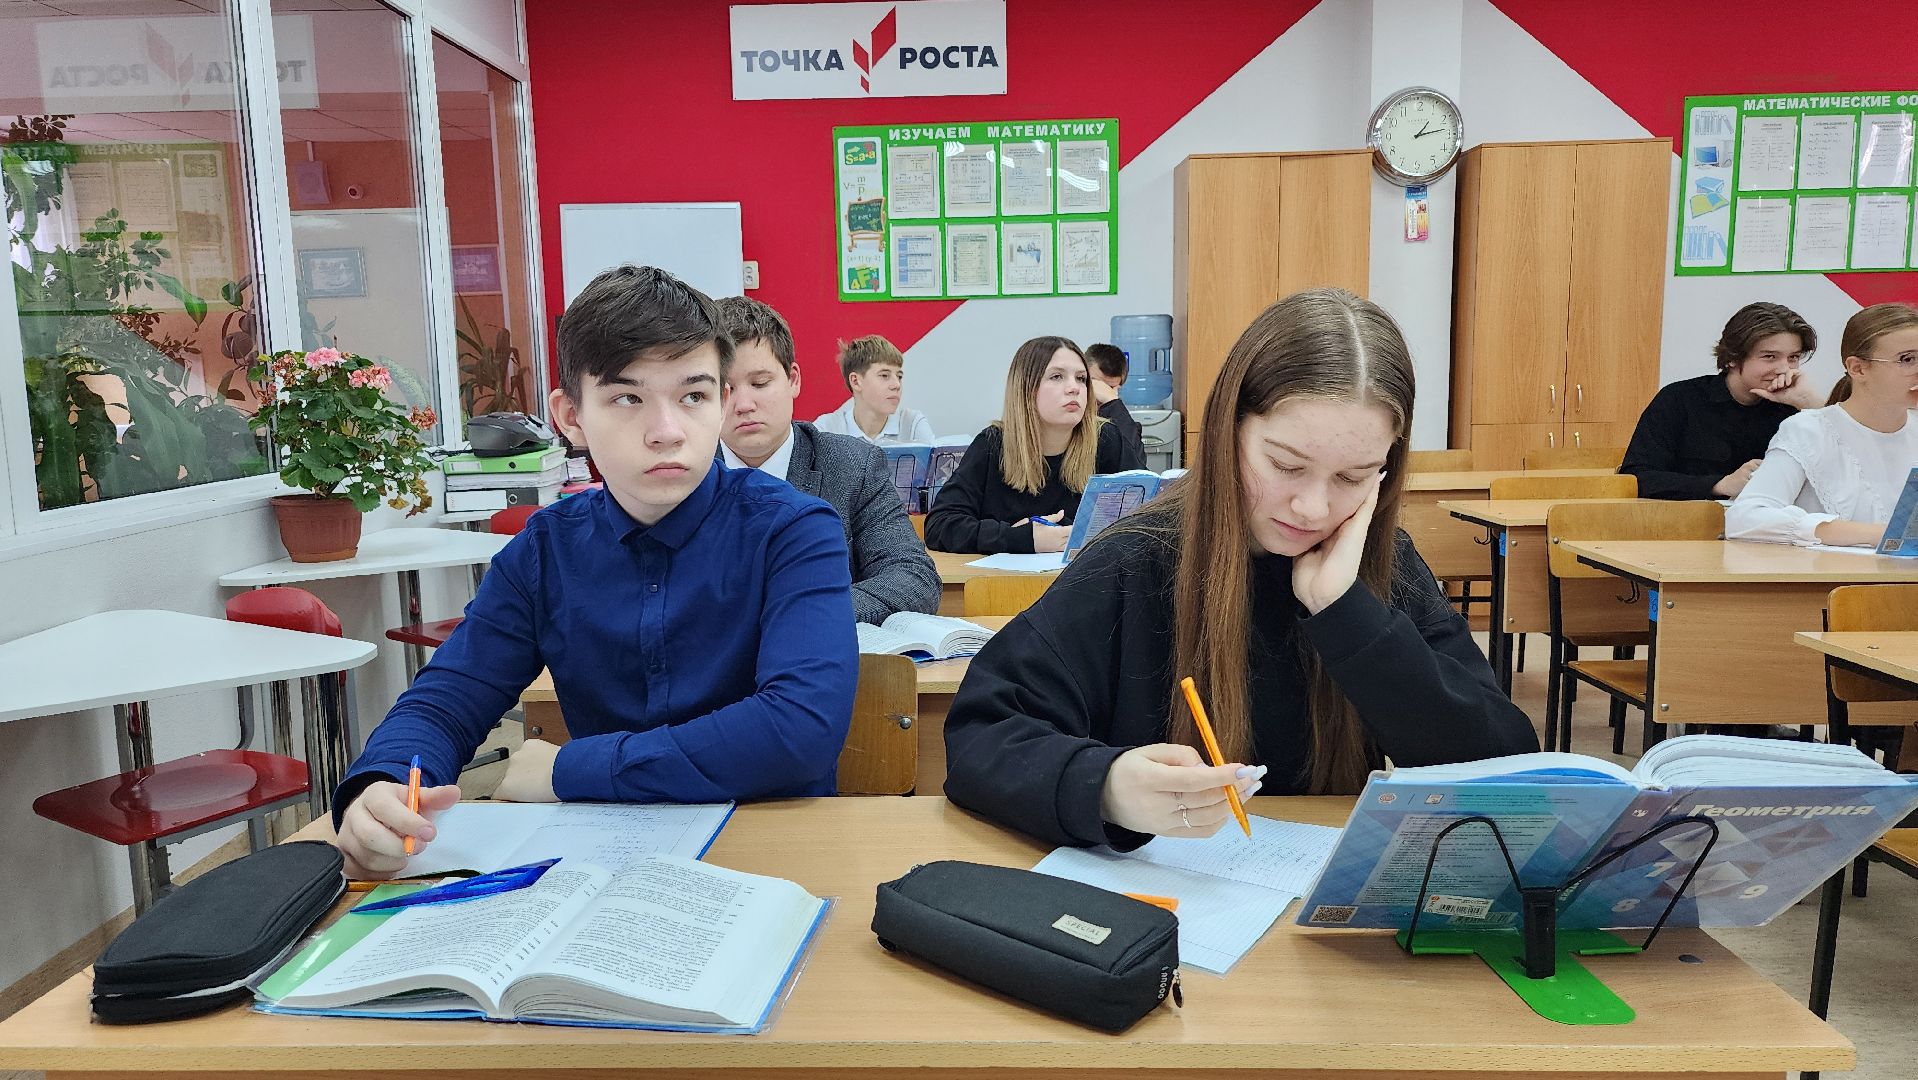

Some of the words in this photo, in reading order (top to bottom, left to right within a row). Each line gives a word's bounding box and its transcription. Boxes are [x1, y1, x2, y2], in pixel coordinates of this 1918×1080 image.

[740, 49, 844, 72] ТОЧКА
[899, 45, 999, 70] РОСТА
[1743, 95, 1891, 111] МАТЕМАТИЧЕСКИЕ
[888, 126, 971, 141] ИЗУЧАЕМ
[987, 122, 1106, 138] МАТЕМАТИКУ
[1687, 804, 1876, 819] Геометрия
[1644, 861, 1677, 878] 7
[1738, 884, 1769, 899] 9
[1611, 898, 1641, 912] 8
[1065, 920, 1100, 936] SPECIAL
